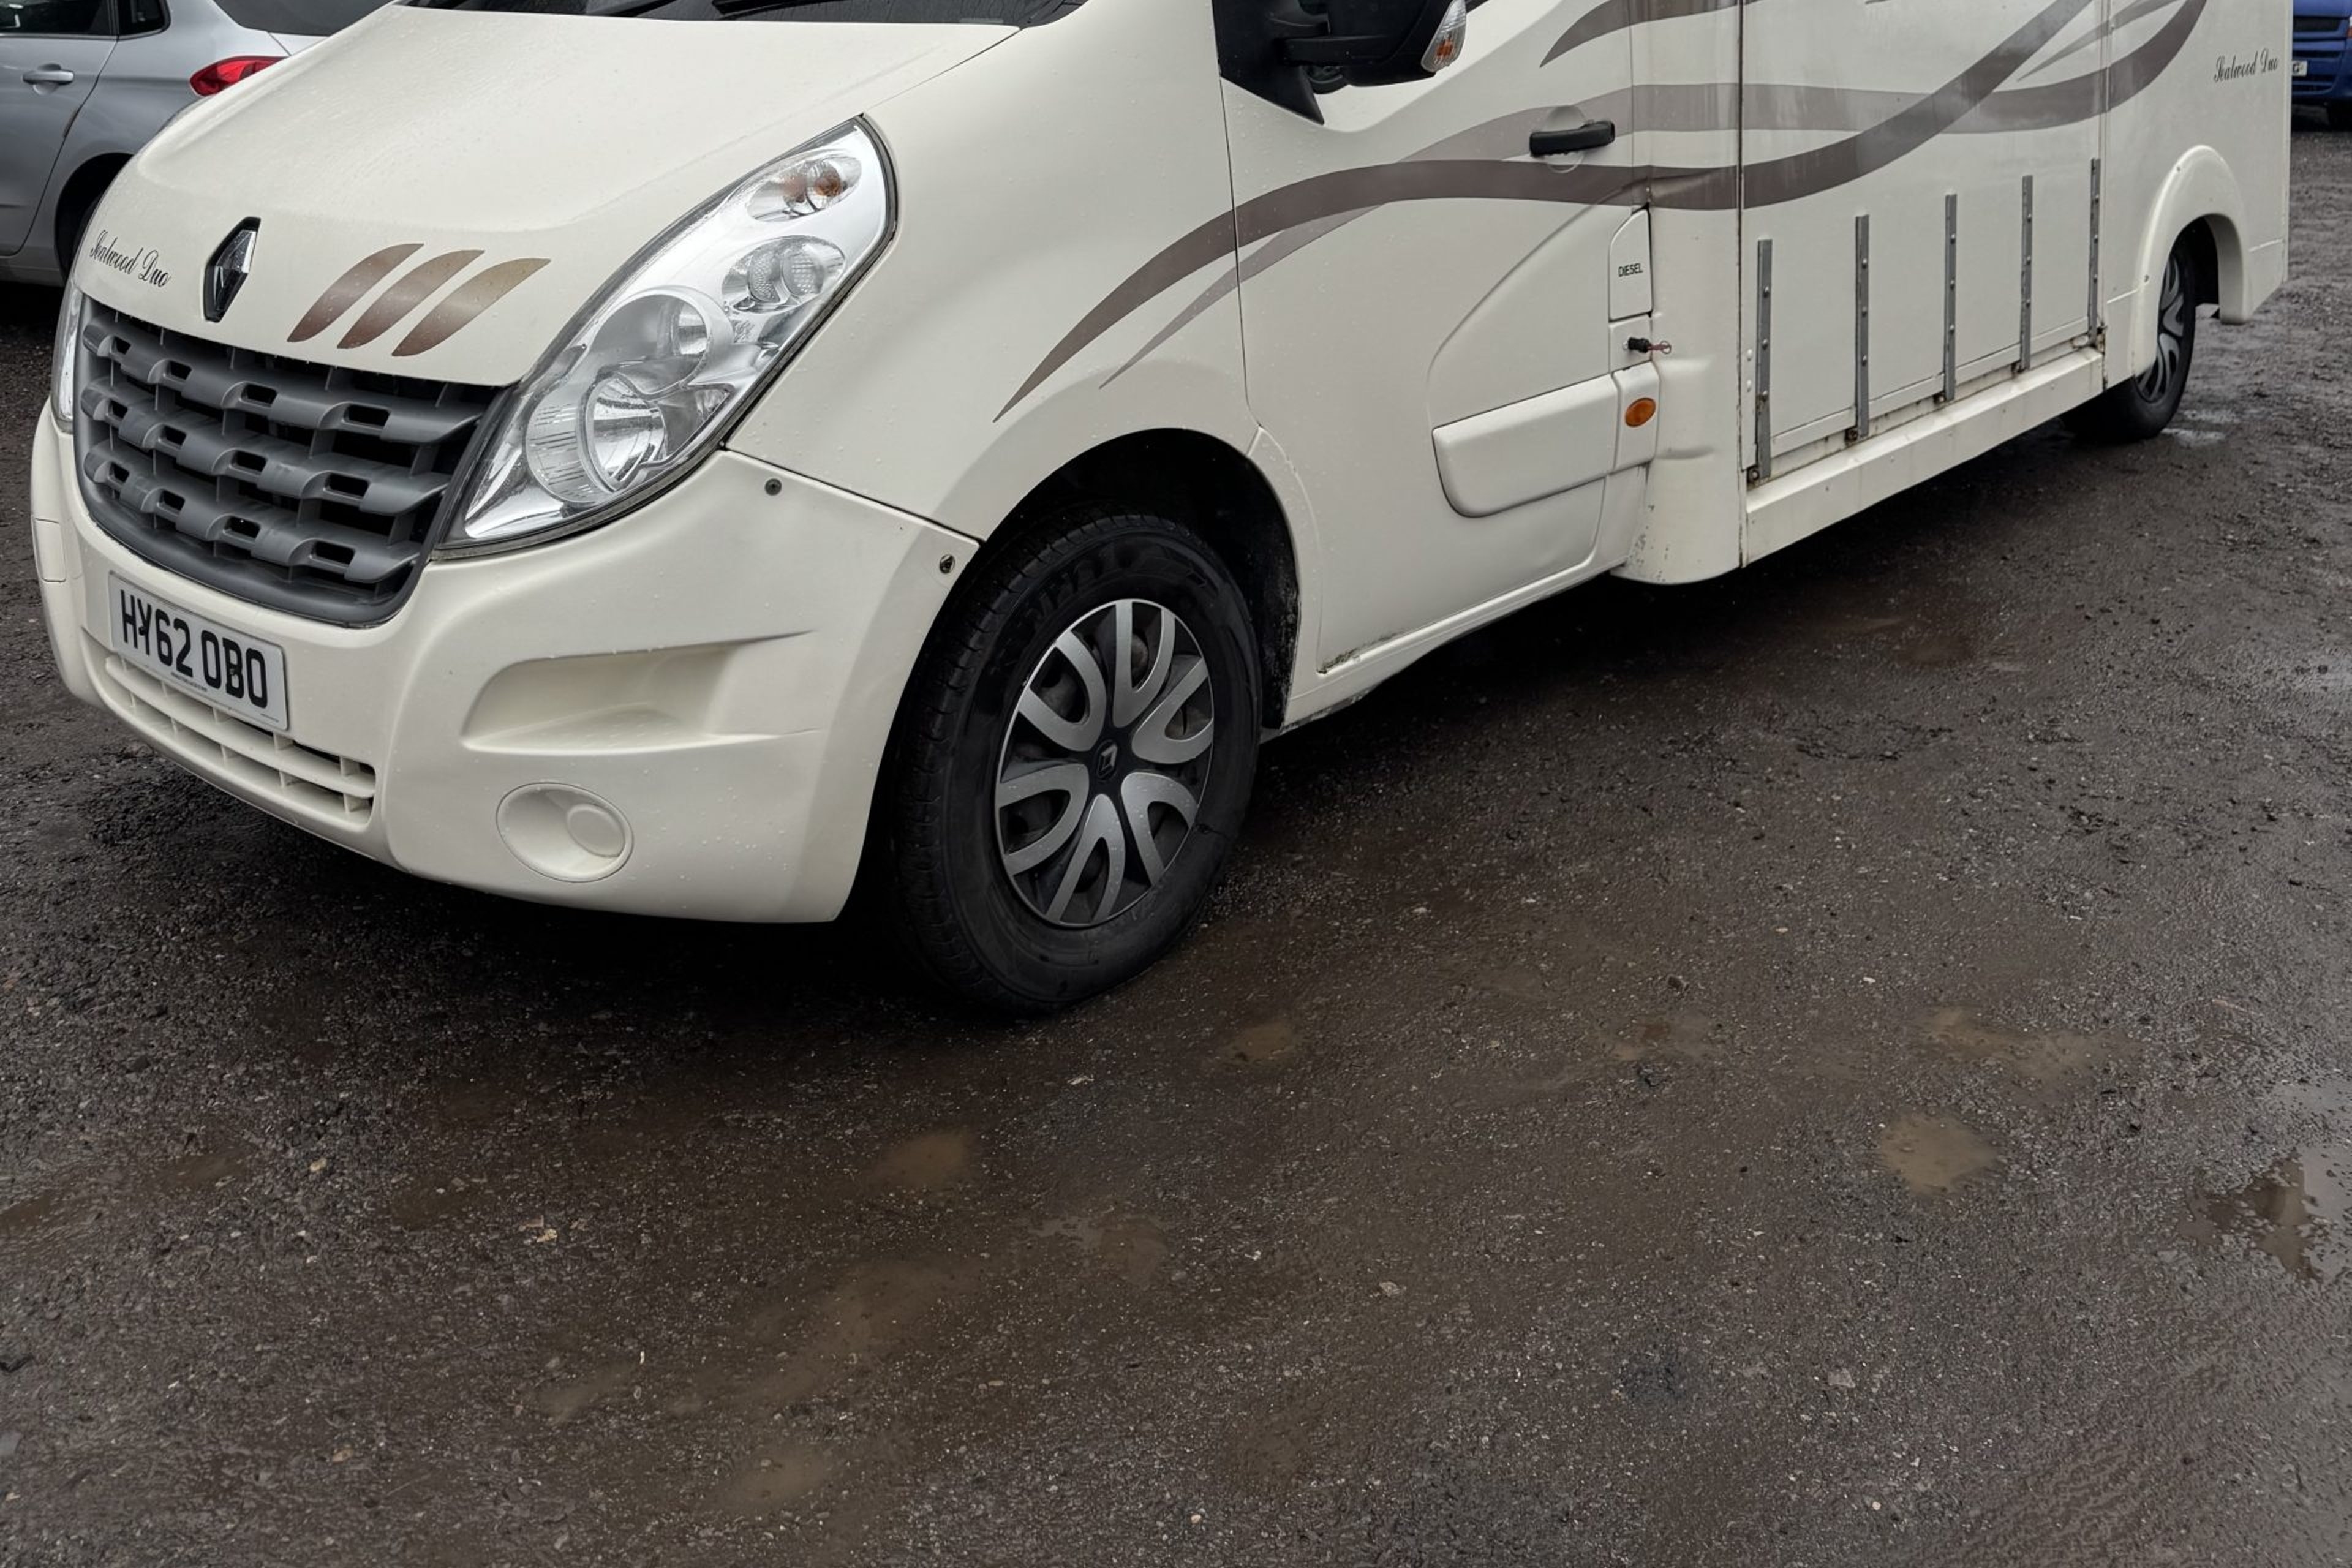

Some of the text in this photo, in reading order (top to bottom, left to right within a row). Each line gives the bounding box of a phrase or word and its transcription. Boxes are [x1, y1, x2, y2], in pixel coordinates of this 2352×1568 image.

[2260, 48, 2278, 74] Duo
[138, 249, 172, 287] Duo
[1618, 263, 1643, 277] DIESEL
[120, 589, 194, 678] HY62
